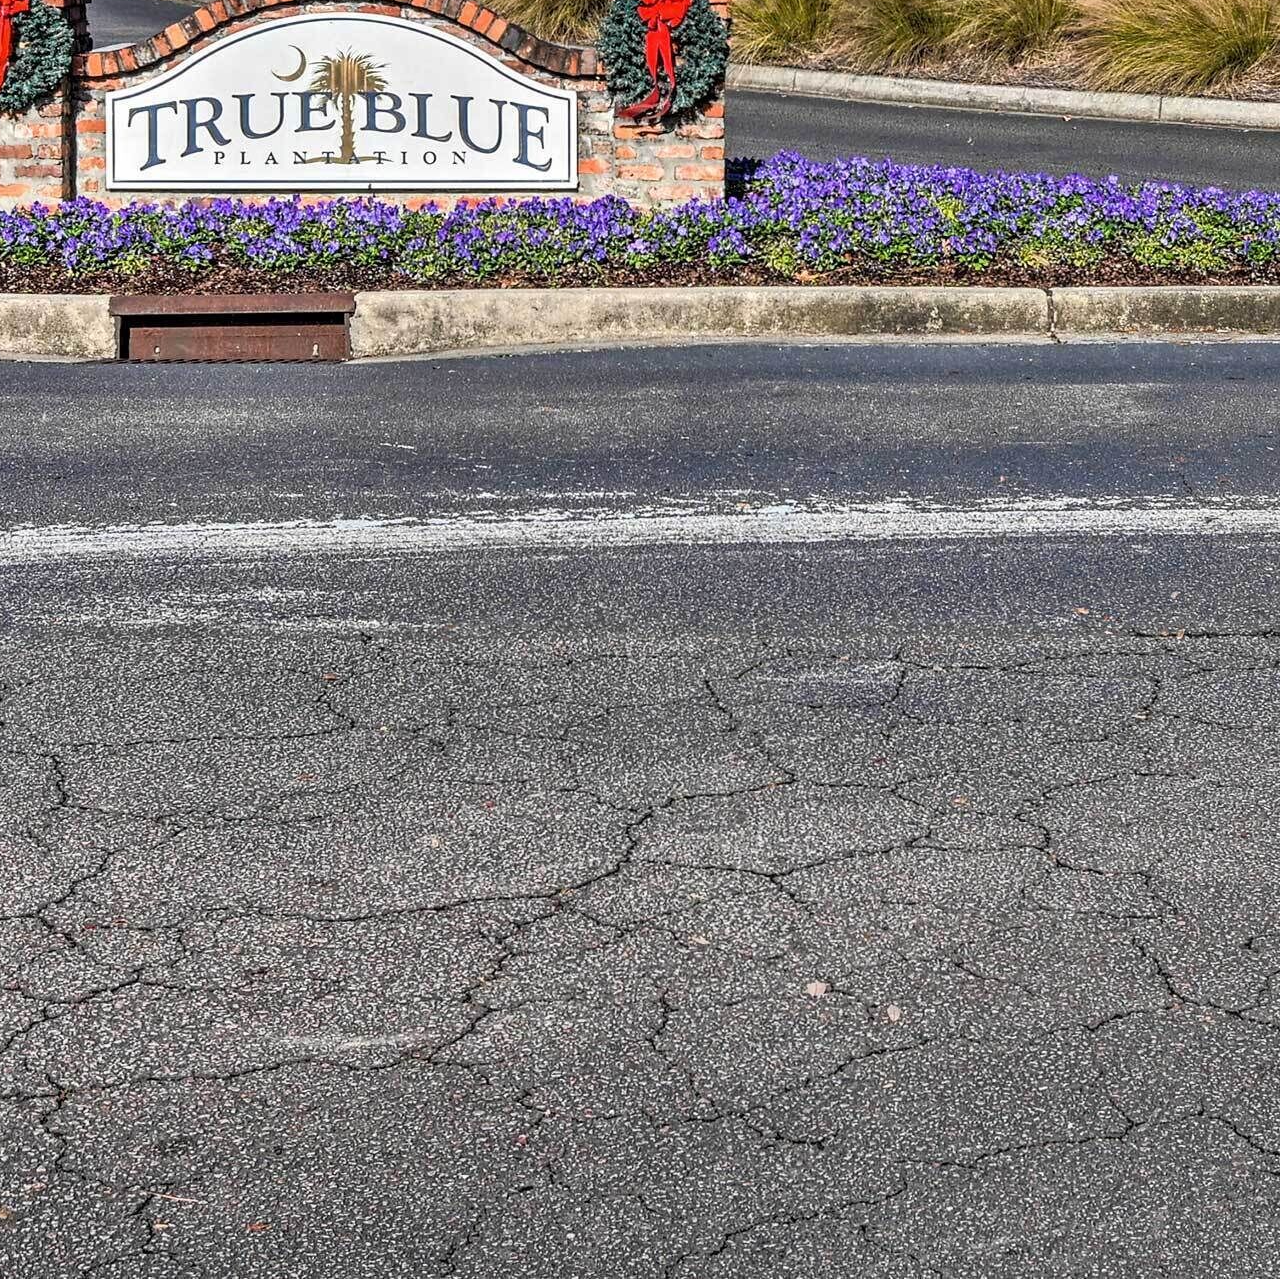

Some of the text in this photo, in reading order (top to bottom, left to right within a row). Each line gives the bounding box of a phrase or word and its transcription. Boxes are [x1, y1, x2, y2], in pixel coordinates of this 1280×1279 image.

[128, 91, 553, 171] TRUE BLUE
[214, 151, 467, 166] PLANTATION
